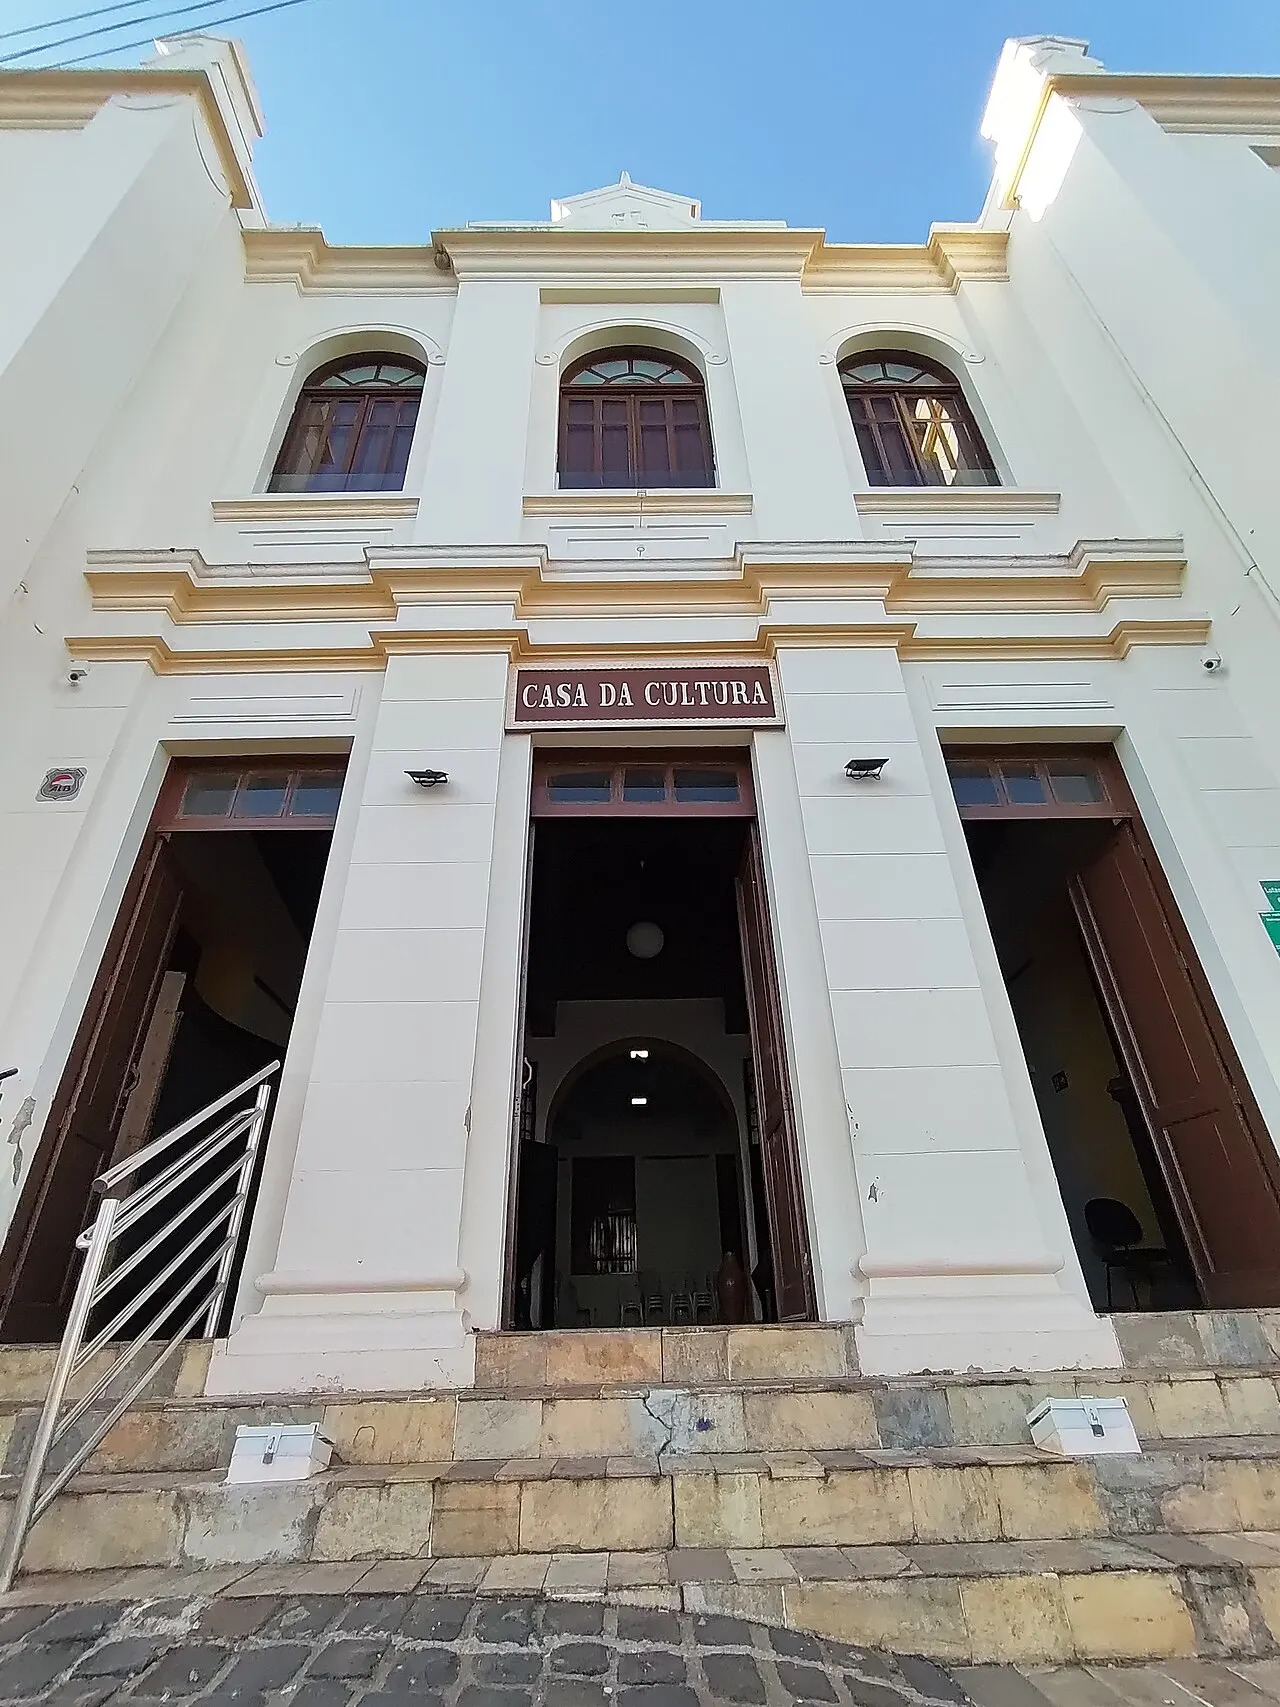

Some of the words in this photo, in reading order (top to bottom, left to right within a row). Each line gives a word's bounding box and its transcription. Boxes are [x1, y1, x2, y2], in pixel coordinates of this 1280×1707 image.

[522, 683, 589, 708] CASA
[599, 682, 634, 707] DA
[644, 680, 768, 707] CULTURA
